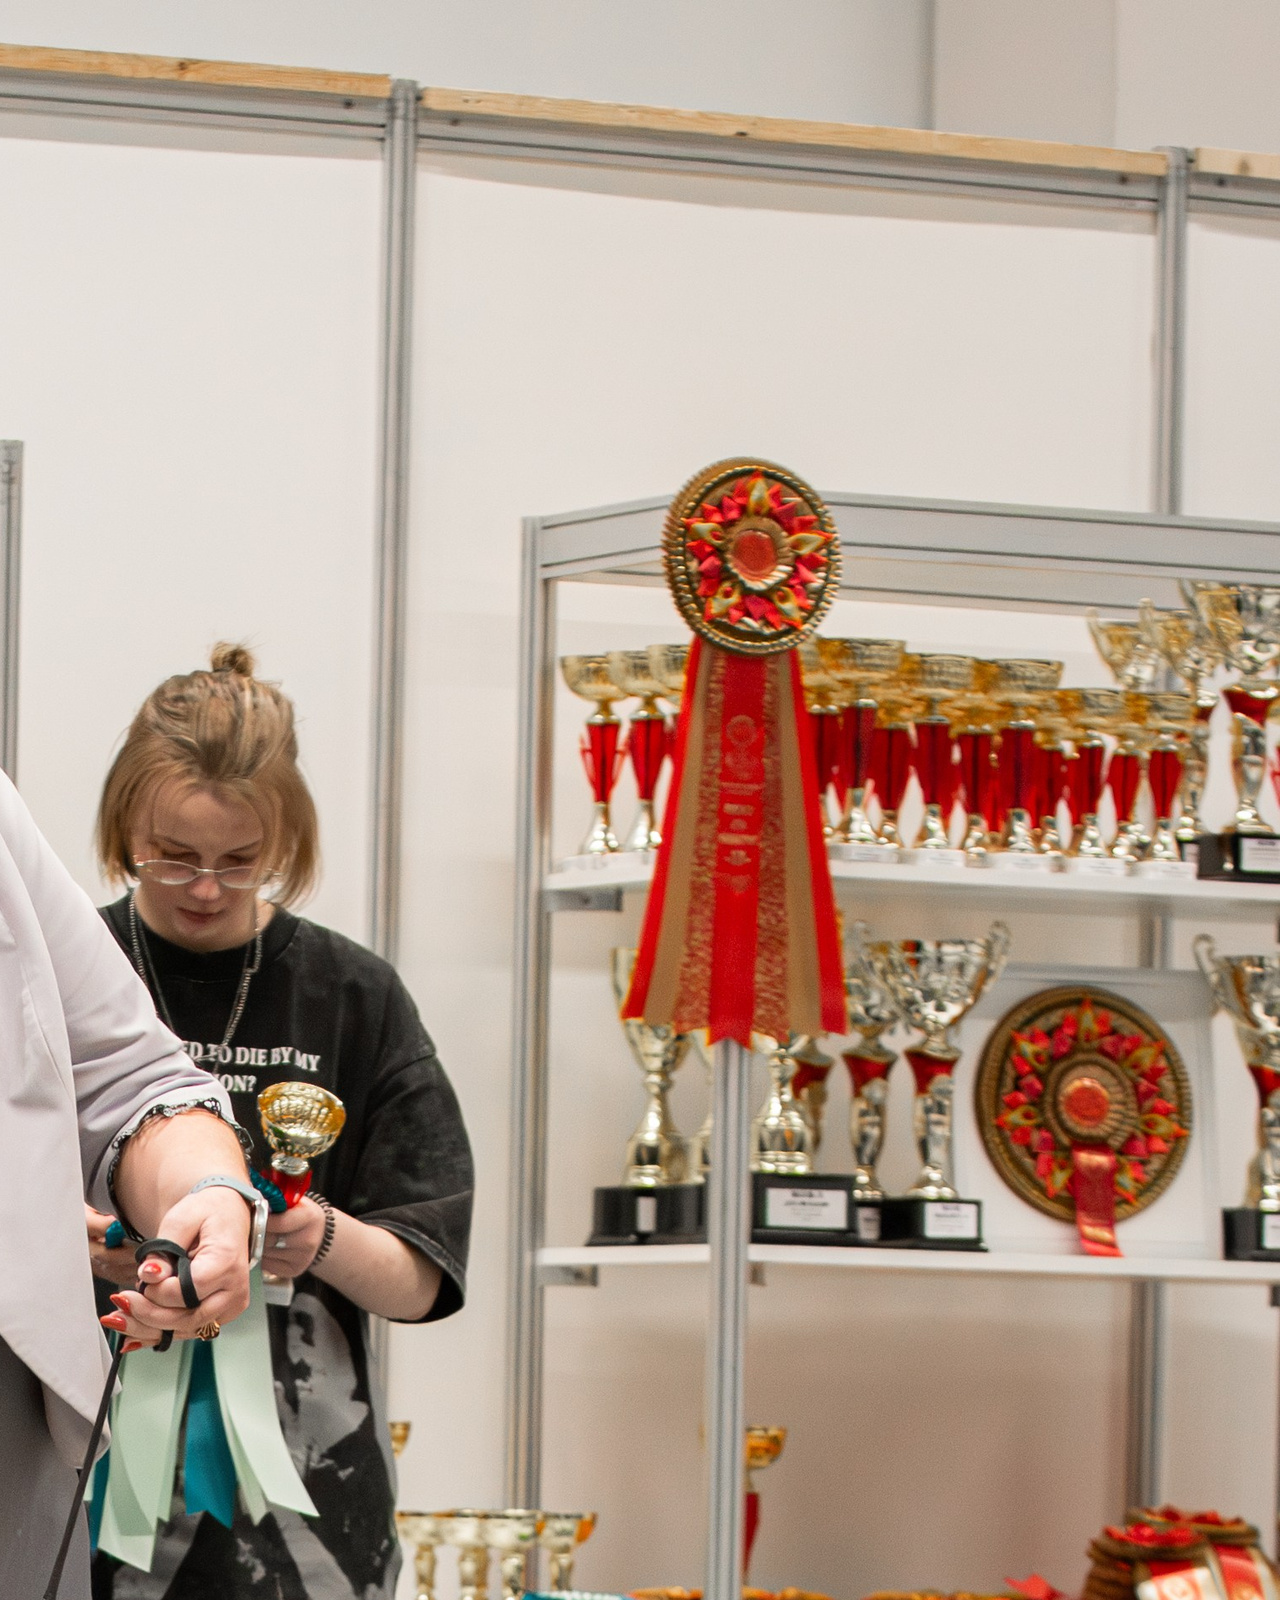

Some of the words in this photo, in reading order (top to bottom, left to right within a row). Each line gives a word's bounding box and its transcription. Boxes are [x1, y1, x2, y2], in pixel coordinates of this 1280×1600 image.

[207, 1043, 232, 1063] TO
[235, 1047, 268, 1065] DIE
[270, 1046, 294, 1065] BY
[295, 1049, 321, 1072] MY
